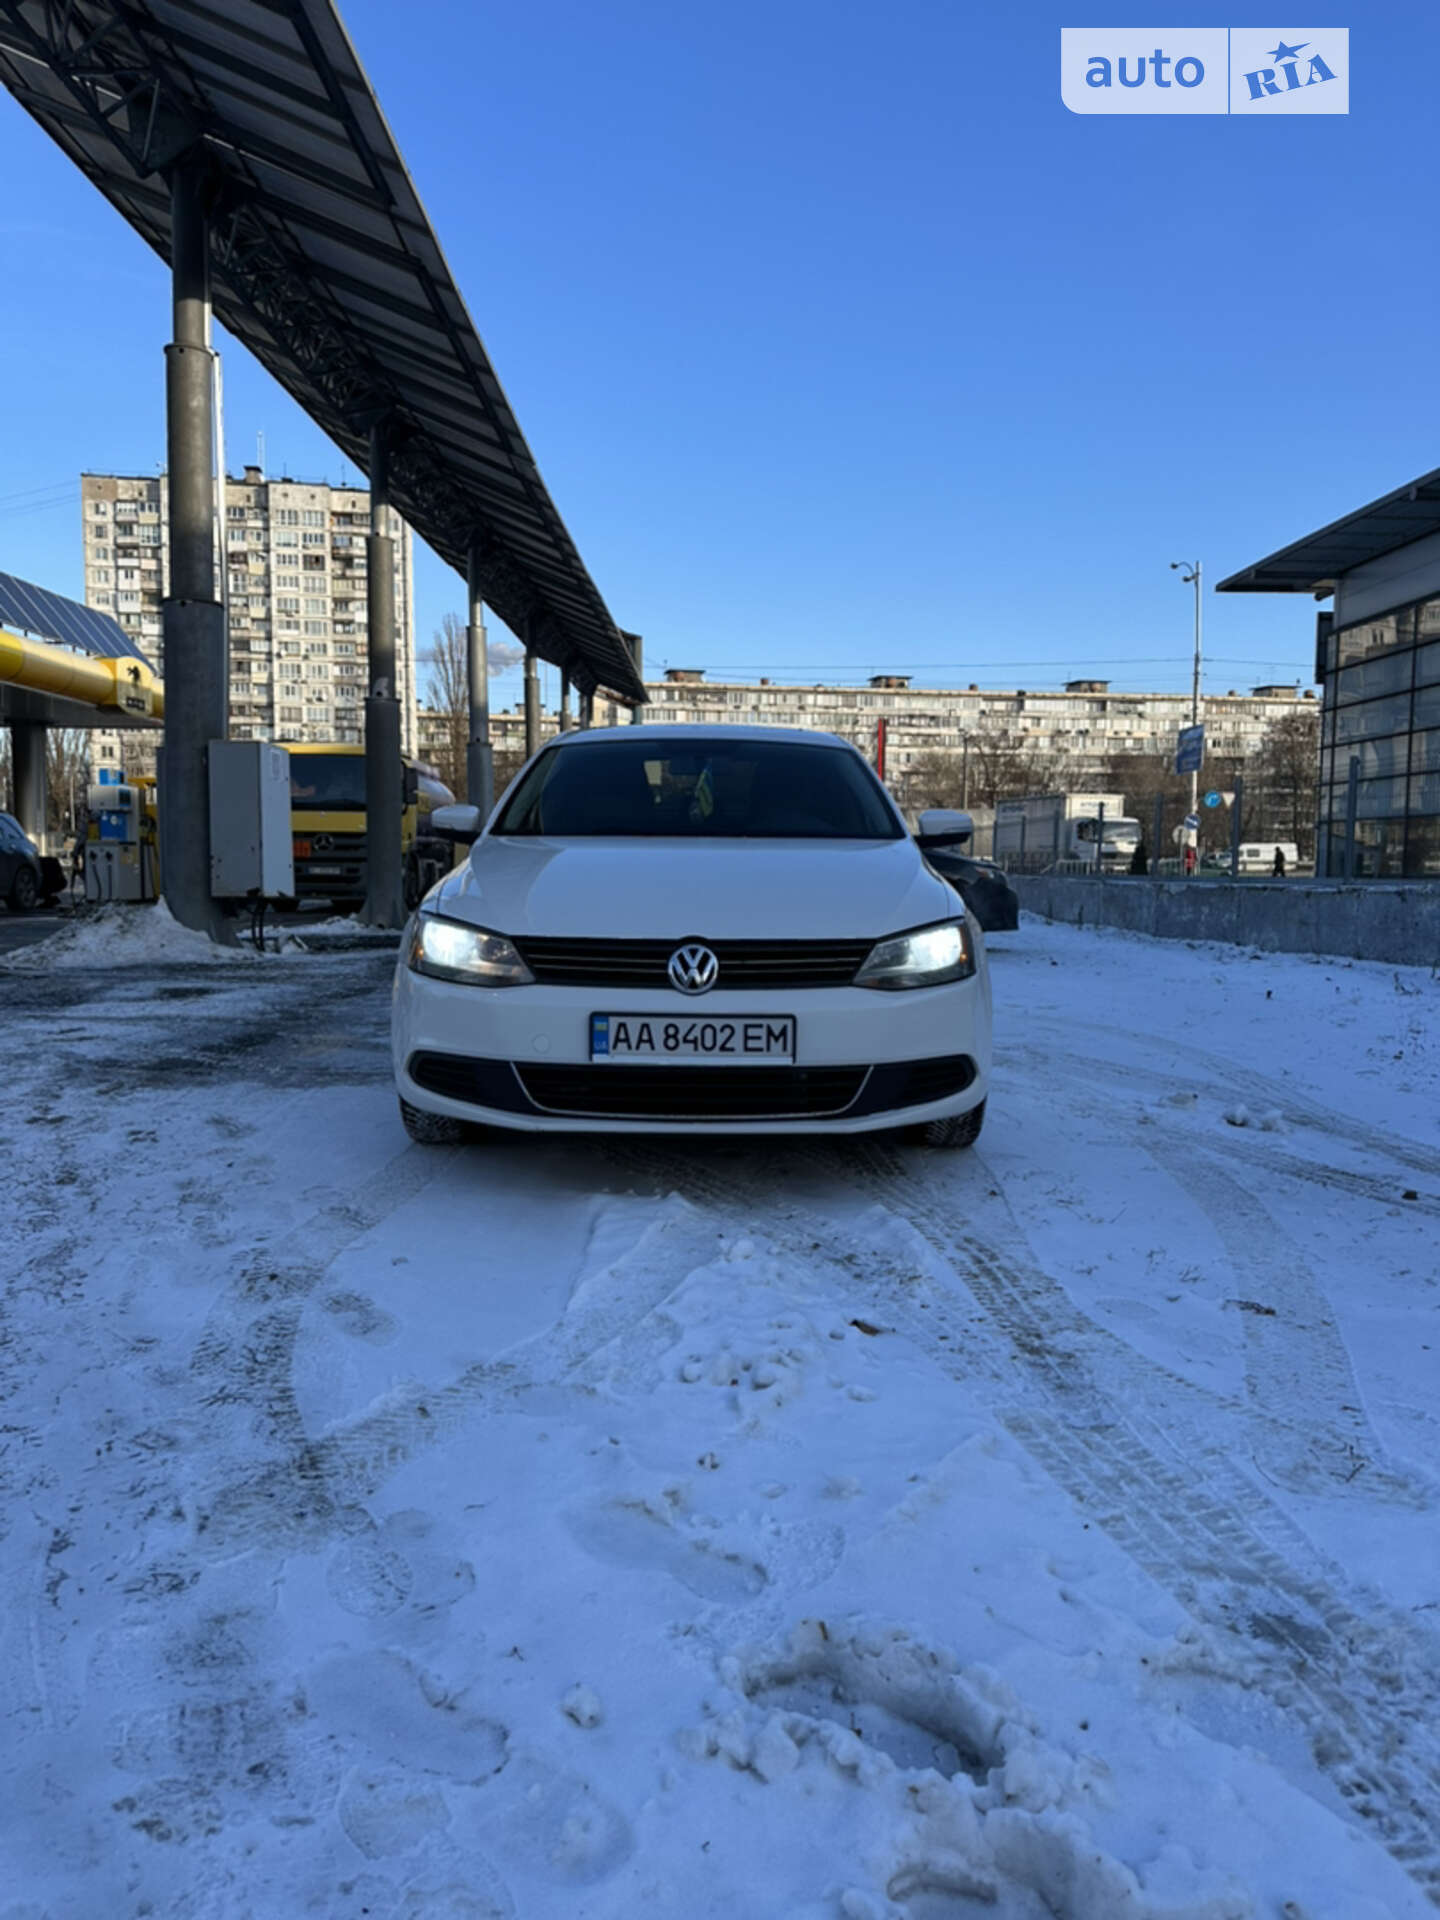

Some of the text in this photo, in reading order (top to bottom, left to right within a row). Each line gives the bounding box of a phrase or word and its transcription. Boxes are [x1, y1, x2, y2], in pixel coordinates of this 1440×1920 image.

[612, 1022, 787, 1052] AA 8402 EM
